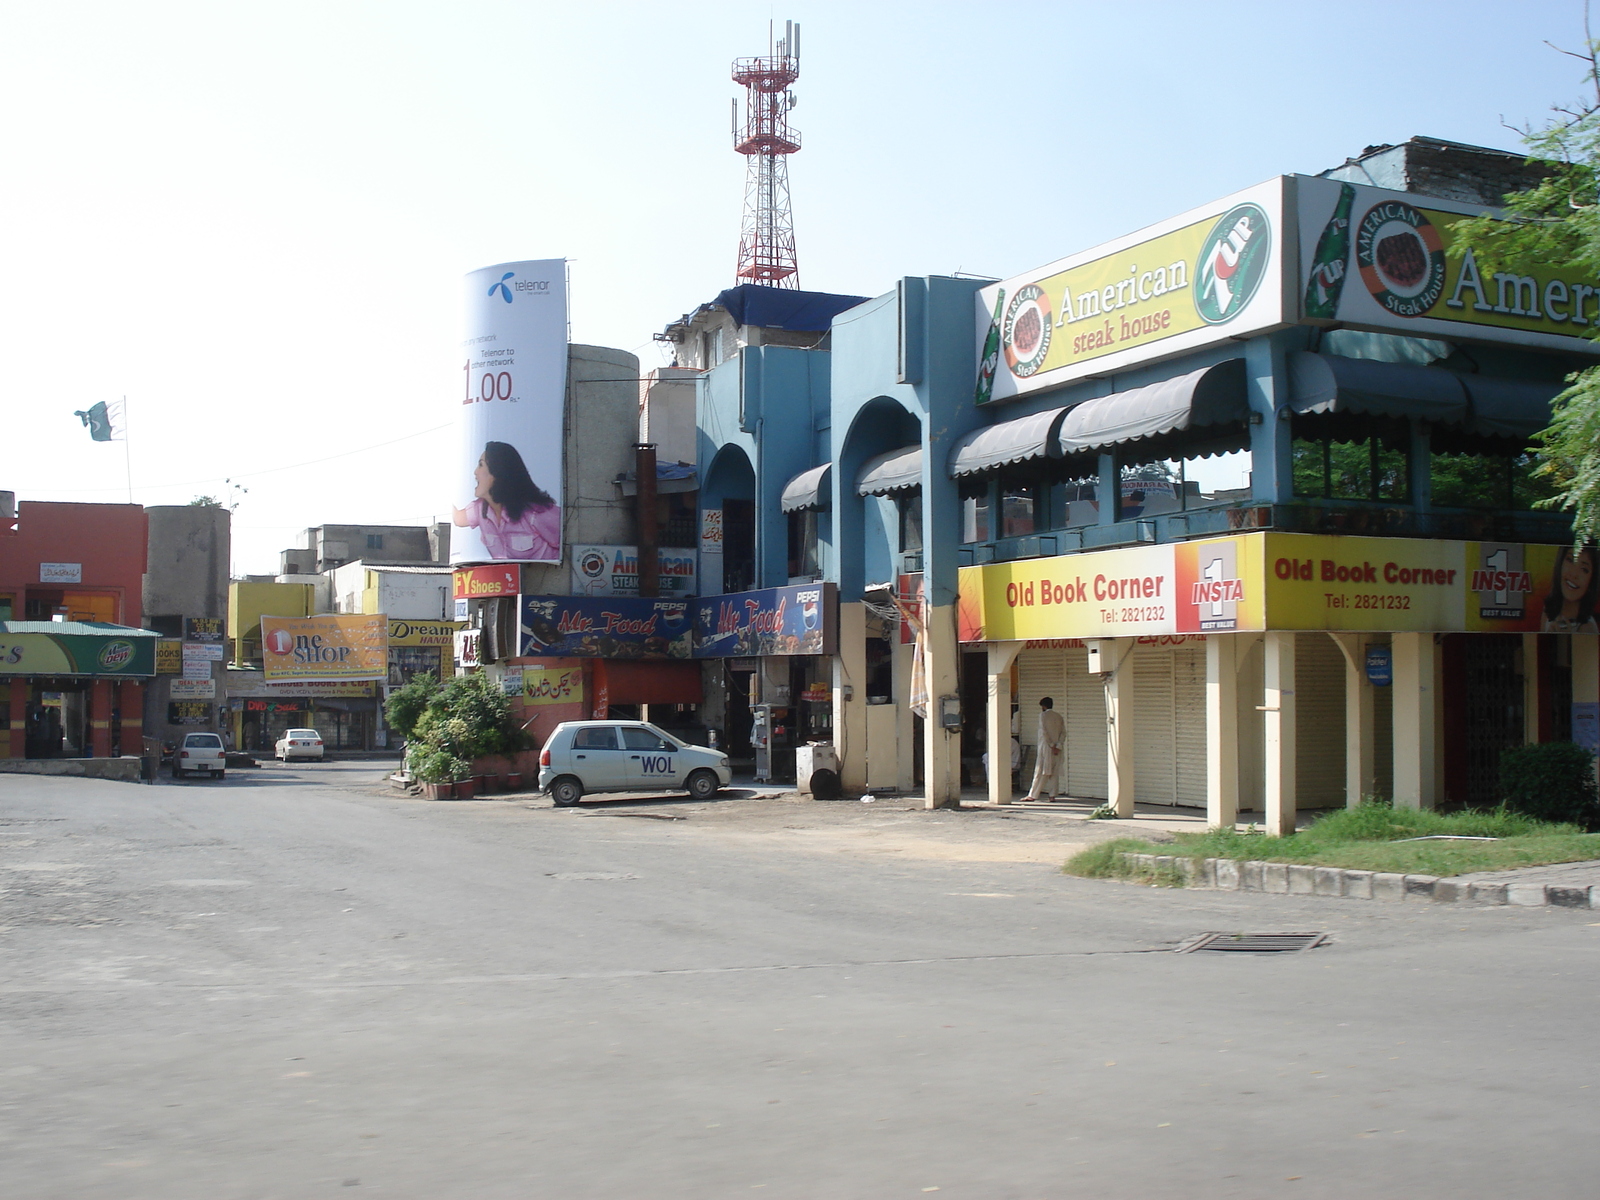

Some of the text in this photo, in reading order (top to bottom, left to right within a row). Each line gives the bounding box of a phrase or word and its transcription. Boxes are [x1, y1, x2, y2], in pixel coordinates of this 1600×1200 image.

[1359, 203, 1421, 262] AMERICAN
[514, 279, 550, 292] telenor
[1055, 259, 1188, 328] American
[1385, 263, 1445, 316] Steak House
[1004, 287, 1039, 344] AMERICAN
[1073, 308, 1171, 354] steak house
[481, 348, 515, 358] Telenor to
[486, 357, 515, 367] network
[1016, 362, 1038, 377] Steak
[463, 358, 512, 405] 1.00
[612, 549, 694, 576] Amican
[1275, 557, 1457, 585] Old Book Corner
[470, 579, 502, 594] Shoes
[1471, 569, 1532, 592] INSTA
[796, 590, 821, 604] PEPSI
[1006, 573, 1165, 608] Old Book Corner
[1191, 578, 1245, 606] INSTA
[653, 602, 687, 611] PEPSI
[1324, 593, 1411, 610] Tel: 2821232
[717, 596, 787, 636] Mr. Food
[1100, 605, 1165, 623] Tel: 2821232
[1482, 609, 1521, 617] BEST VALUE
[388, 621, 454, 639] Dream
[556, 609, 659, 636] Mr. Food
[1201, 619, 1236, 629] BEST VALUE
[1051, 638, 1087, 649] CORNE
[293, 646, 351, 664] SHOP
[549, 672, 571, 699] چکن
[247, 700, 267, 710] DVD
[641, 756, 676, 773] WOL
